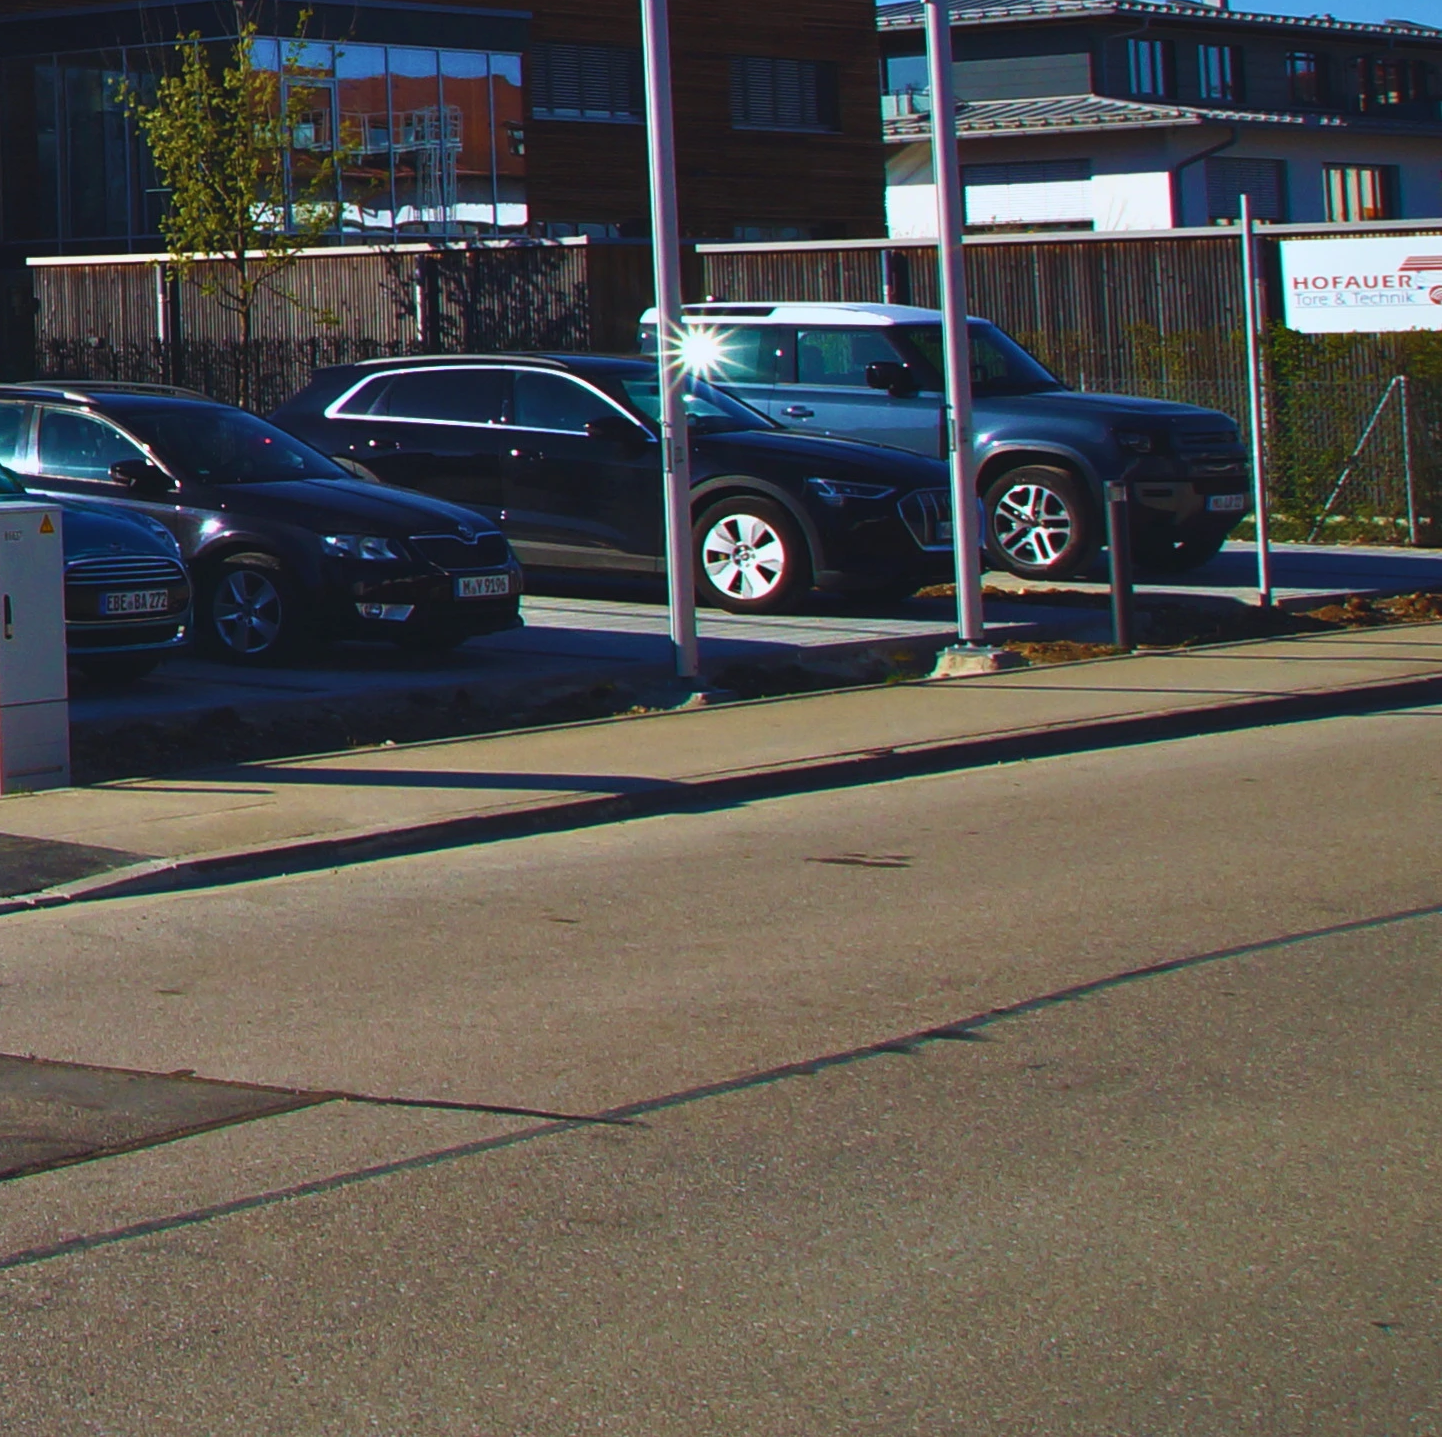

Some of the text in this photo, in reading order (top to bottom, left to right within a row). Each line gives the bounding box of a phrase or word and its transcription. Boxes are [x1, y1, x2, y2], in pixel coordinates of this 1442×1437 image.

[1293, 274, 1412, 290] HOFAUER
[1295, 291, 1415, 306] Tore & Technik
